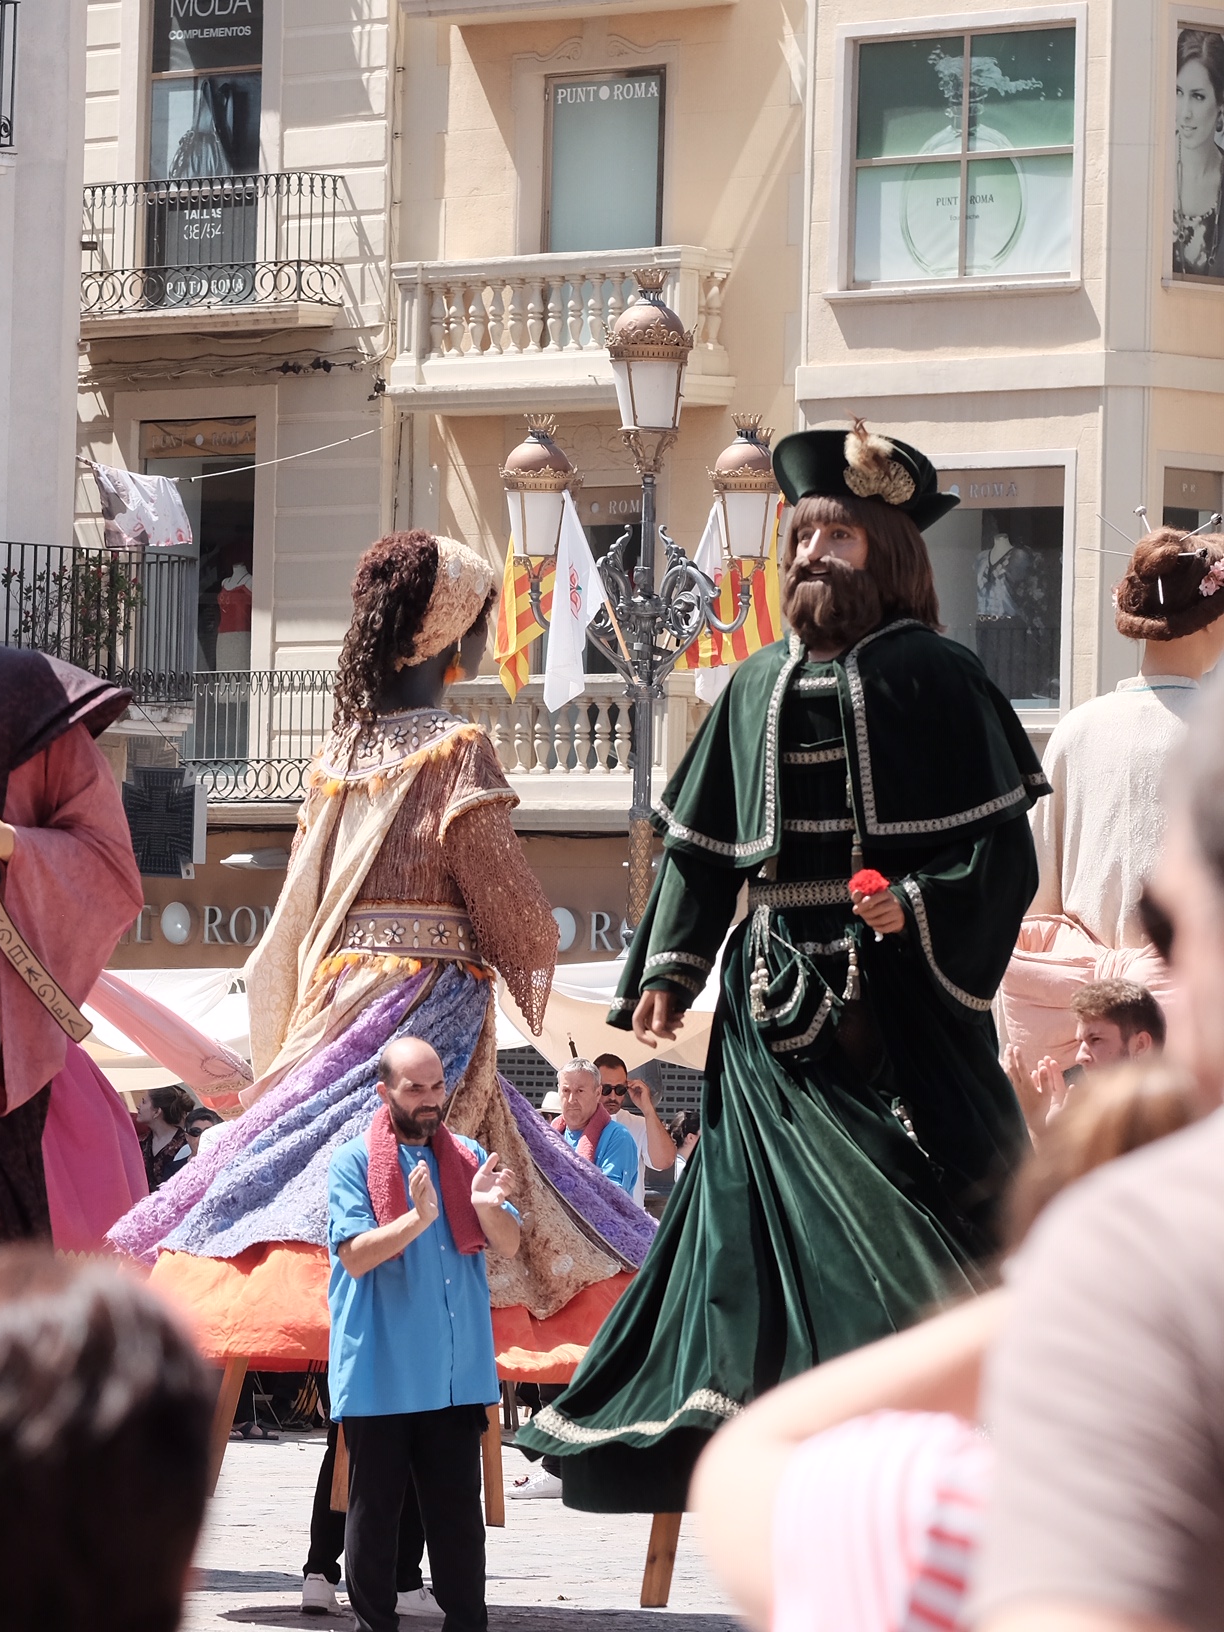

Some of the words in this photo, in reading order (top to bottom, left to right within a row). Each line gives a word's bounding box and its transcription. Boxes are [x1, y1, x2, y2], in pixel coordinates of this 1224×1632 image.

[168, 25, 252, 41] COMPLEMENTOS
[613, 81, 659, 101] ROMA
[936, 196, 960, 206] PUNT
[969, 193, 995, 205] ROMA
[183, 207, 223, 220] TALLAS
[183, 222, 225, 241] 38/54
[210, 278, 244, 295] ROMA
[211, 429, 252, 447] ROMA
[969, 482, 1018, 498] ROMA
[608, 500, 641, 515] ROM
